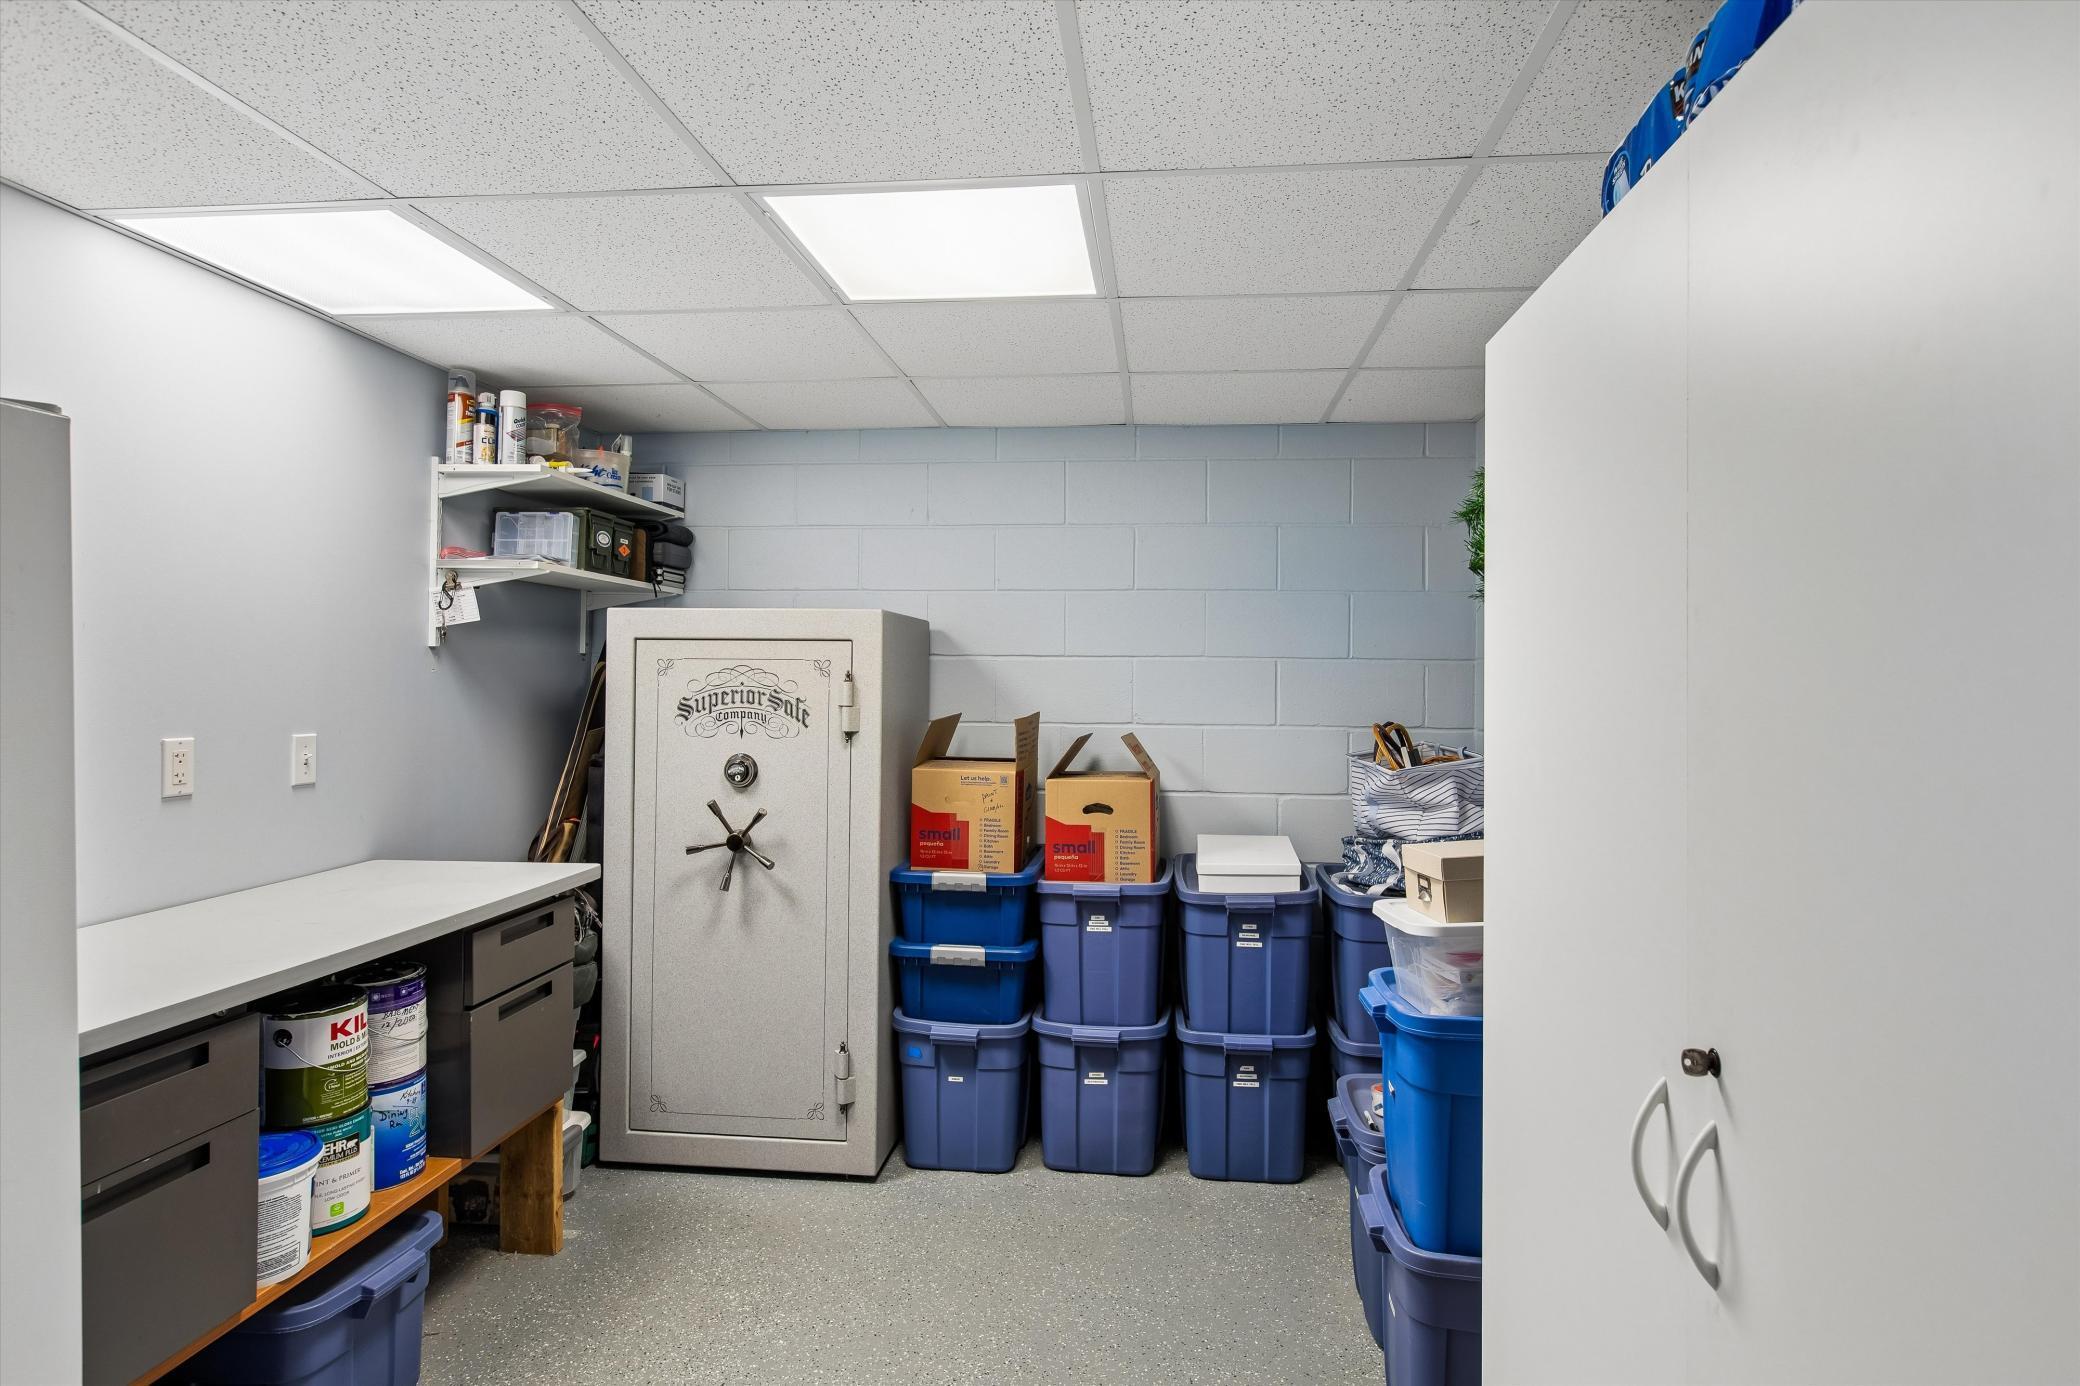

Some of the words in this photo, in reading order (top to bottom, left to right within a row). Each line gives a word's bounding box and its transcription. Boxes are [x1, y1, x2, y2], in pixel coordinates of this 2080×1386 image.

[675, 688, 768, 722] Superior
[767, 687, 811, 729] Safe
[920, 827, 960, 840] small
[1053, 840, 1096, 854] small
[330, 1036, 356, 1051] MOLD
[327, 1047, 353, 1060] INTERIOR
[379, 1108, 409, 1122] Dining
